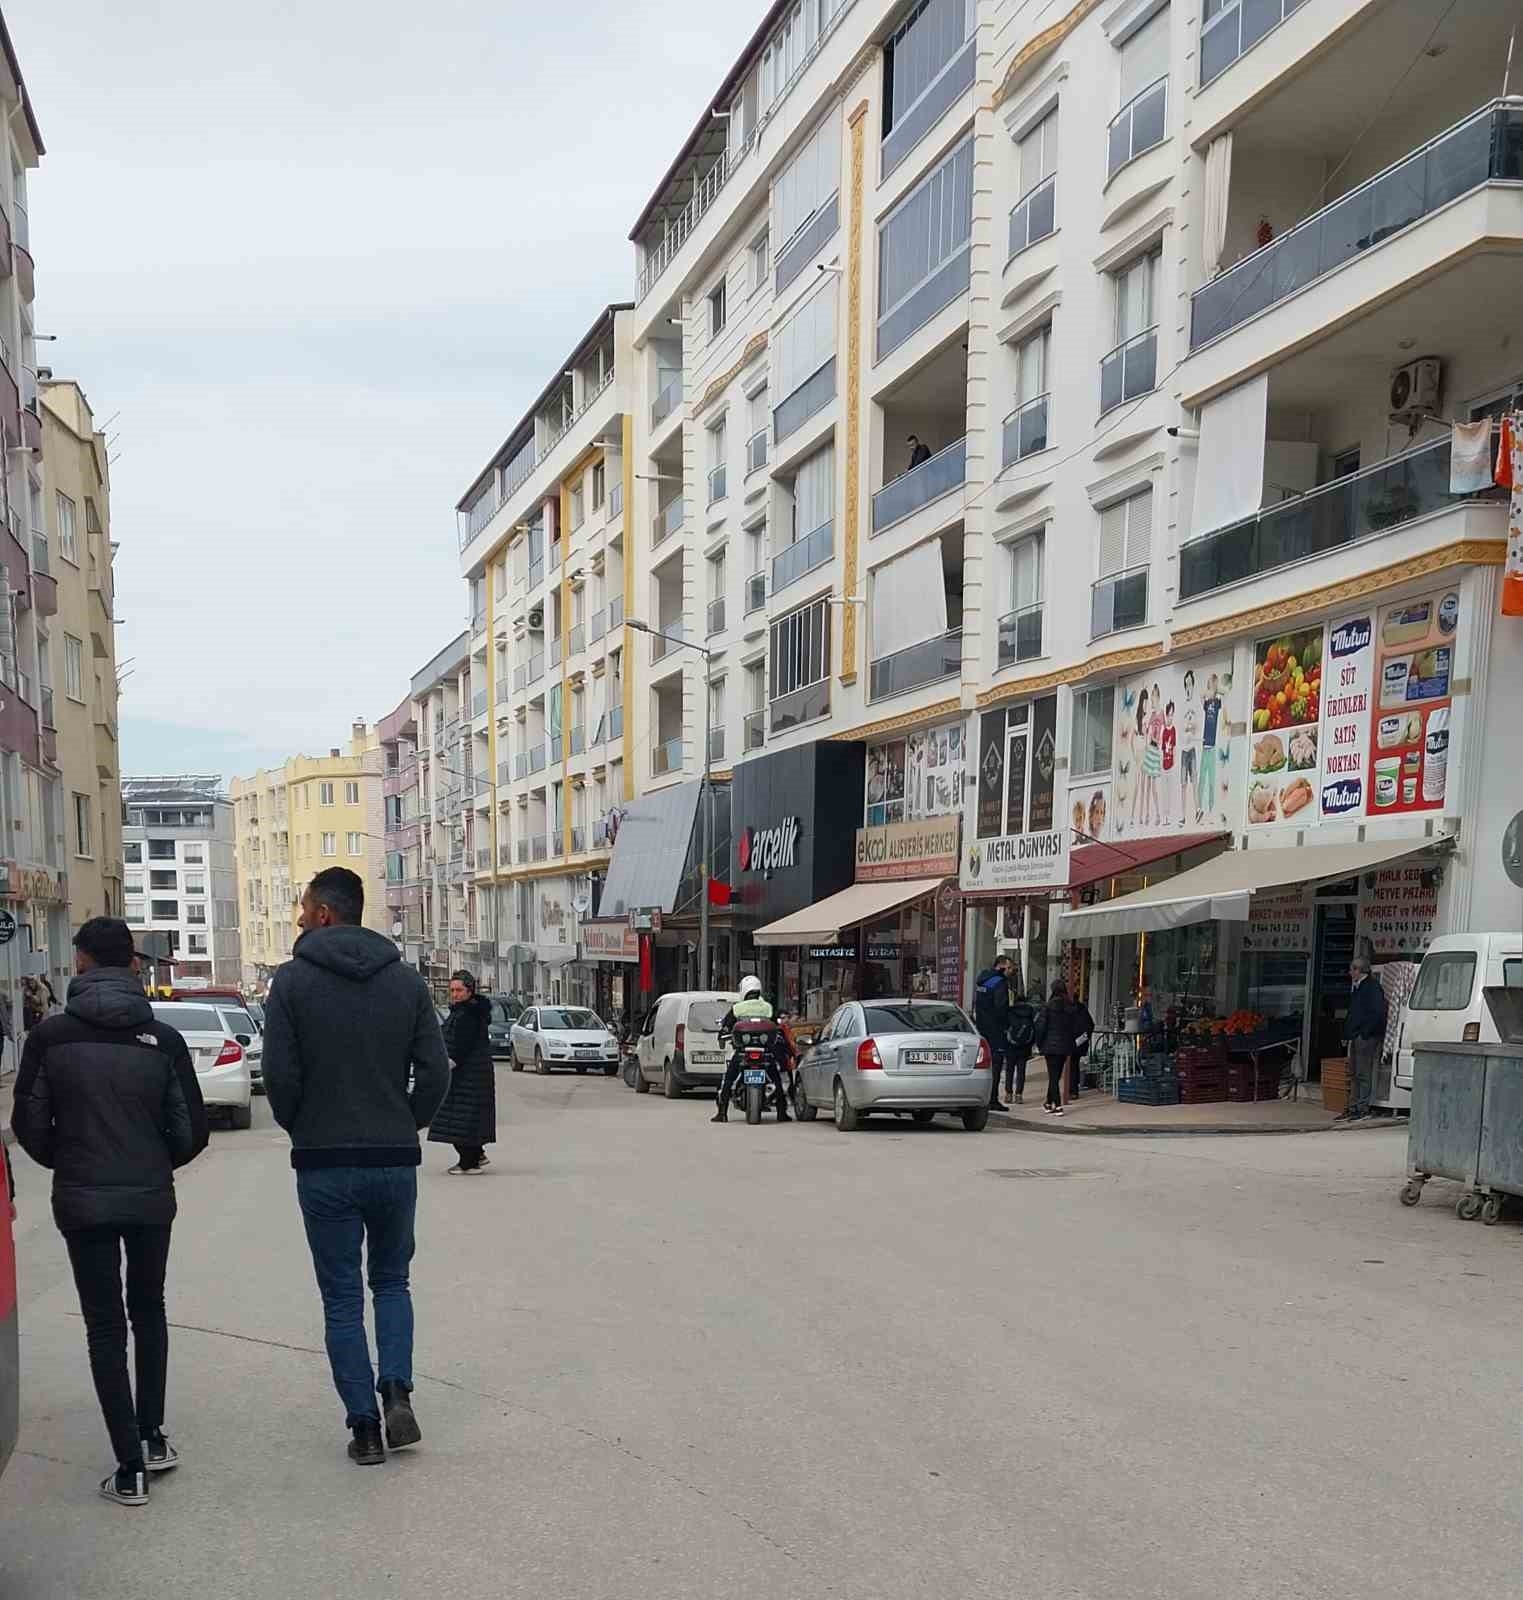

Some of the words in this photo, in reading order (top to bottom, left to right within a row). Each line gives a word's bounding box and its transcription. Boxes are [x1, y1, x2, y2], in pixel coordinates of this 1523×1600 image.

[1332, 627, 1370, 652] Mutun
[1340, 661, 1357, 687] SÜT
[1327, 688, 1368, 718] ÜRÜNLERİ
[1333, 724, 1357, 748] SATIŞ
[1326, 752, 1361, 775] NOKTASI
[1323, 786, 1360, 808] Mutun
[751, 816, 797, 880] arçelik
[987, 840, 1015, 862] METAL
